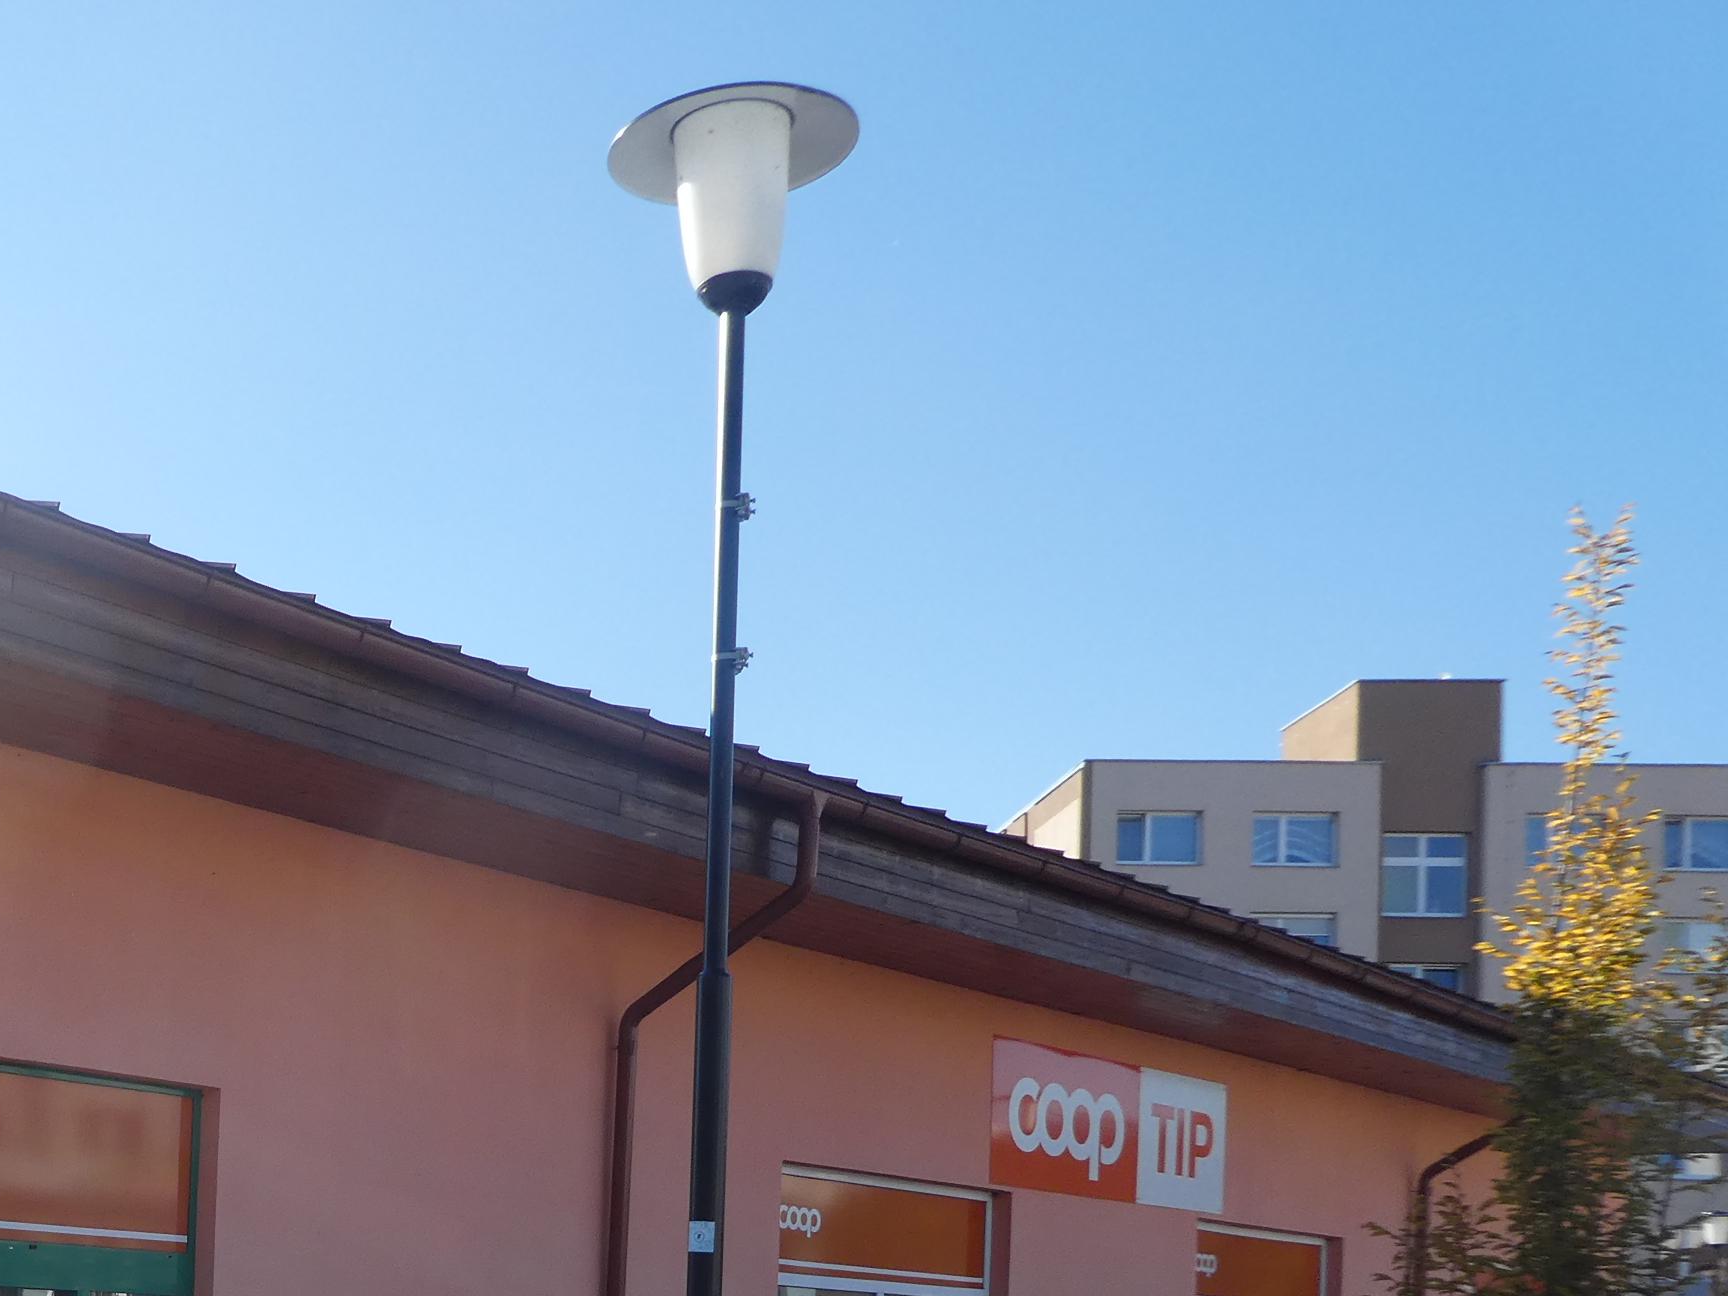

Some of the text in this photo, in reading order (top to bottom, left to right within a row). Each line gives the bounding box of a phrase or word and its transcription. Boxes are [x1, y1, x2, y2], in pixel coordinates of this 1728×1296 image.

[1008, 1077, 1214, 1181] coop TIP
[779, 1205, 821, 1238] coop
